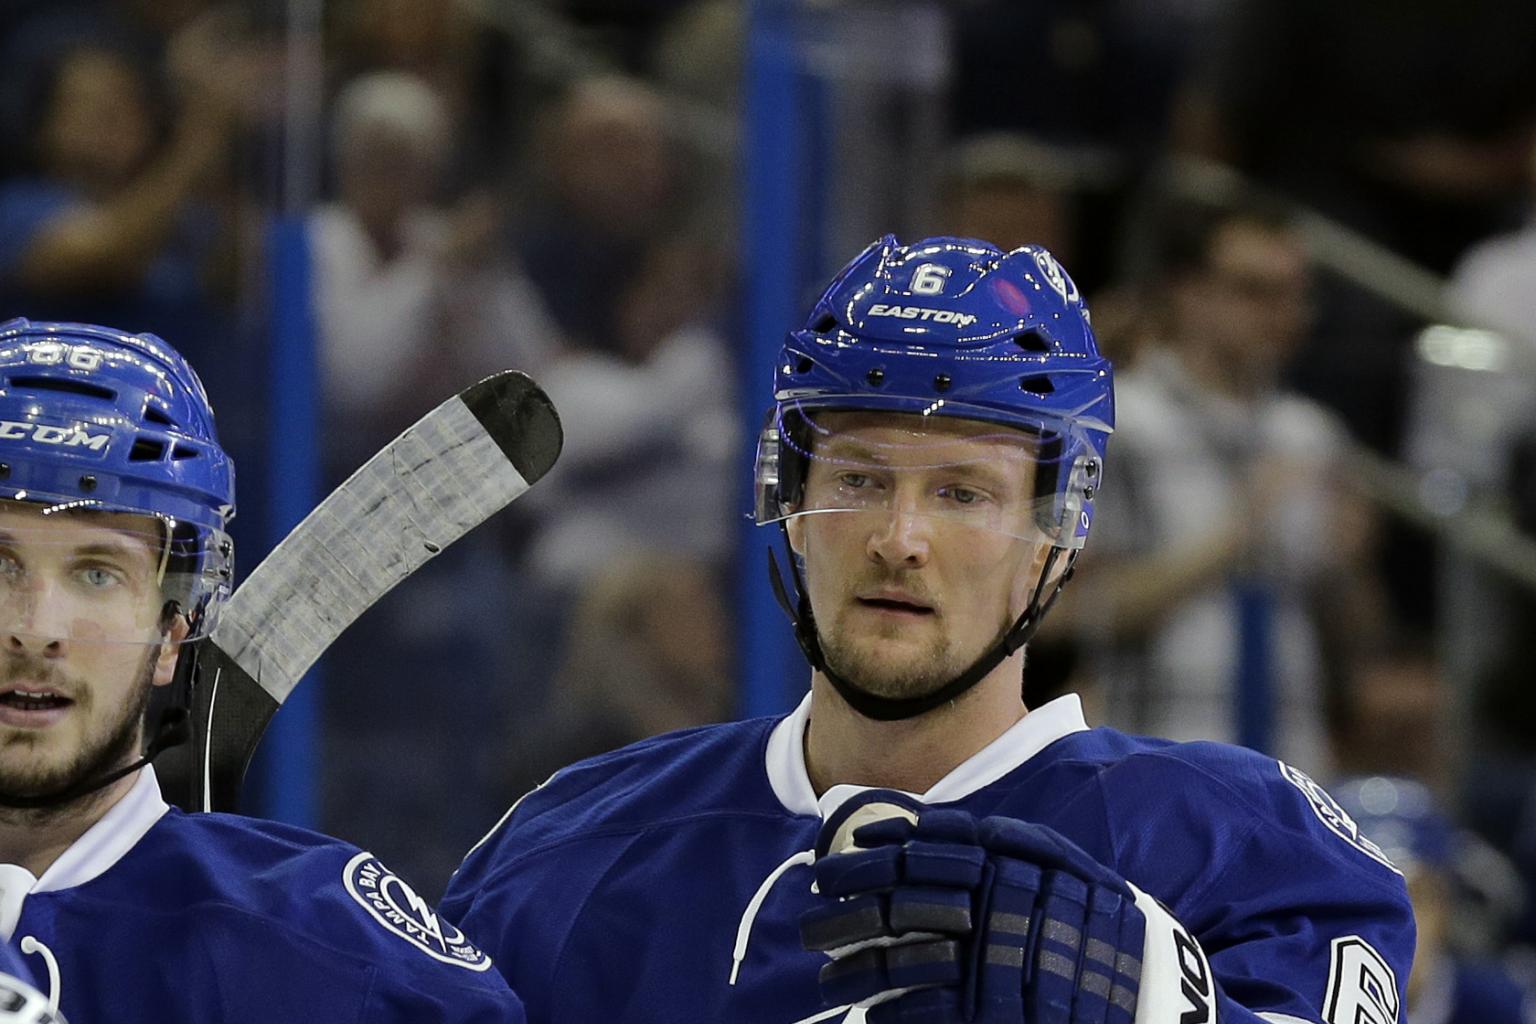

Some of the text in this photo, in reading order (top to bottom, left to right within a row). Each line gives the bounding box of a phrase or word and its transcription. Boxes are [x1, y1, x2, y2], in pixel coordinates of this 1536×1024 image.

[909, 263, 952, 295] 6
[868, 304, 975, 325] EASTON
[358, 862, 430, 945] TAMPA BAY
